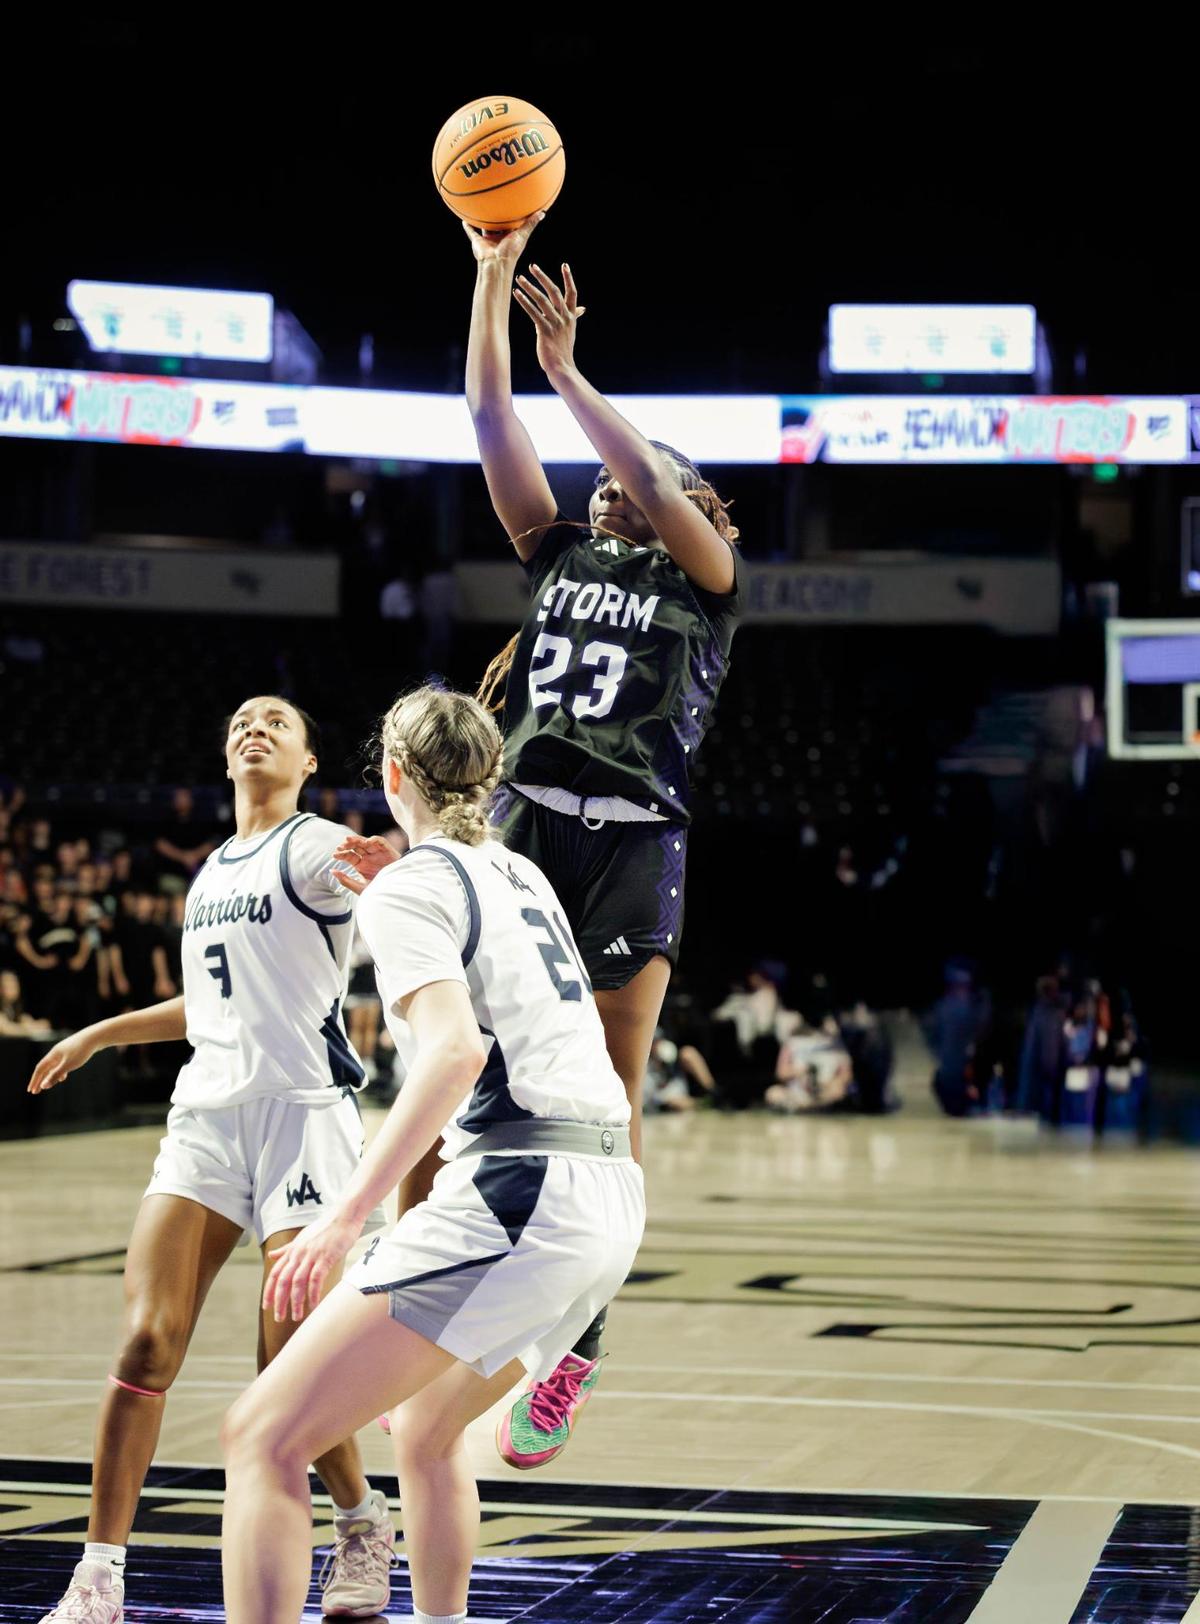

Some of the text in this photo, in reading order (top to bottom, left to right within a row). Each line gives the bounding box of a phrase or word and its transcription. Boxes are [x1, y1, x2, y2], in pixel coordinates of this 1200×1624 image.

[460, 127, 549, 178] Wilson
[537, 577, 662, 633] STORM
[528, 632, 628, 719] 23
[285, 1172, 324, 1208] WA
